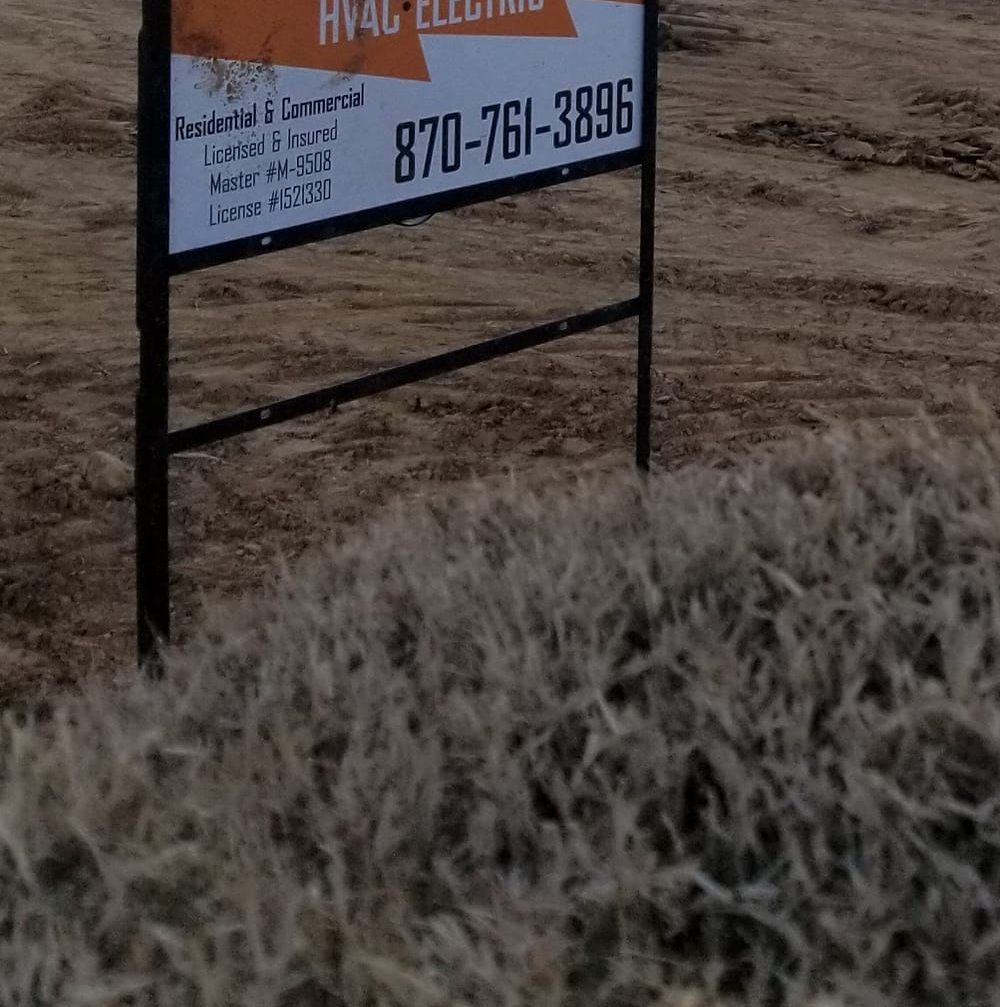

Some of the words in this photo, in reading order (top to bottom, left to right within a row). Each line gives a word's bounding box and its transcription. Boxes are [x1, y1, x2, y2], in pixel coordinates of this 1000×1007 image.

[175, 103, 257, 142] Residential
[264, 99, 275, 125] &
[281, 82, 365, 122] Commercial
[394, 77, 634, 185] 870-761-3896
[204, 133, 265, 167] Licensed
[271, 130, 282, 153] &
[287, 119, 339, 150] Insured
[210, 171, 260, 197] Master
[265, 149, 332, 184] #M-9508
[209, 200, 262, 226] License
[268, 178, 332, 214] #1521330
